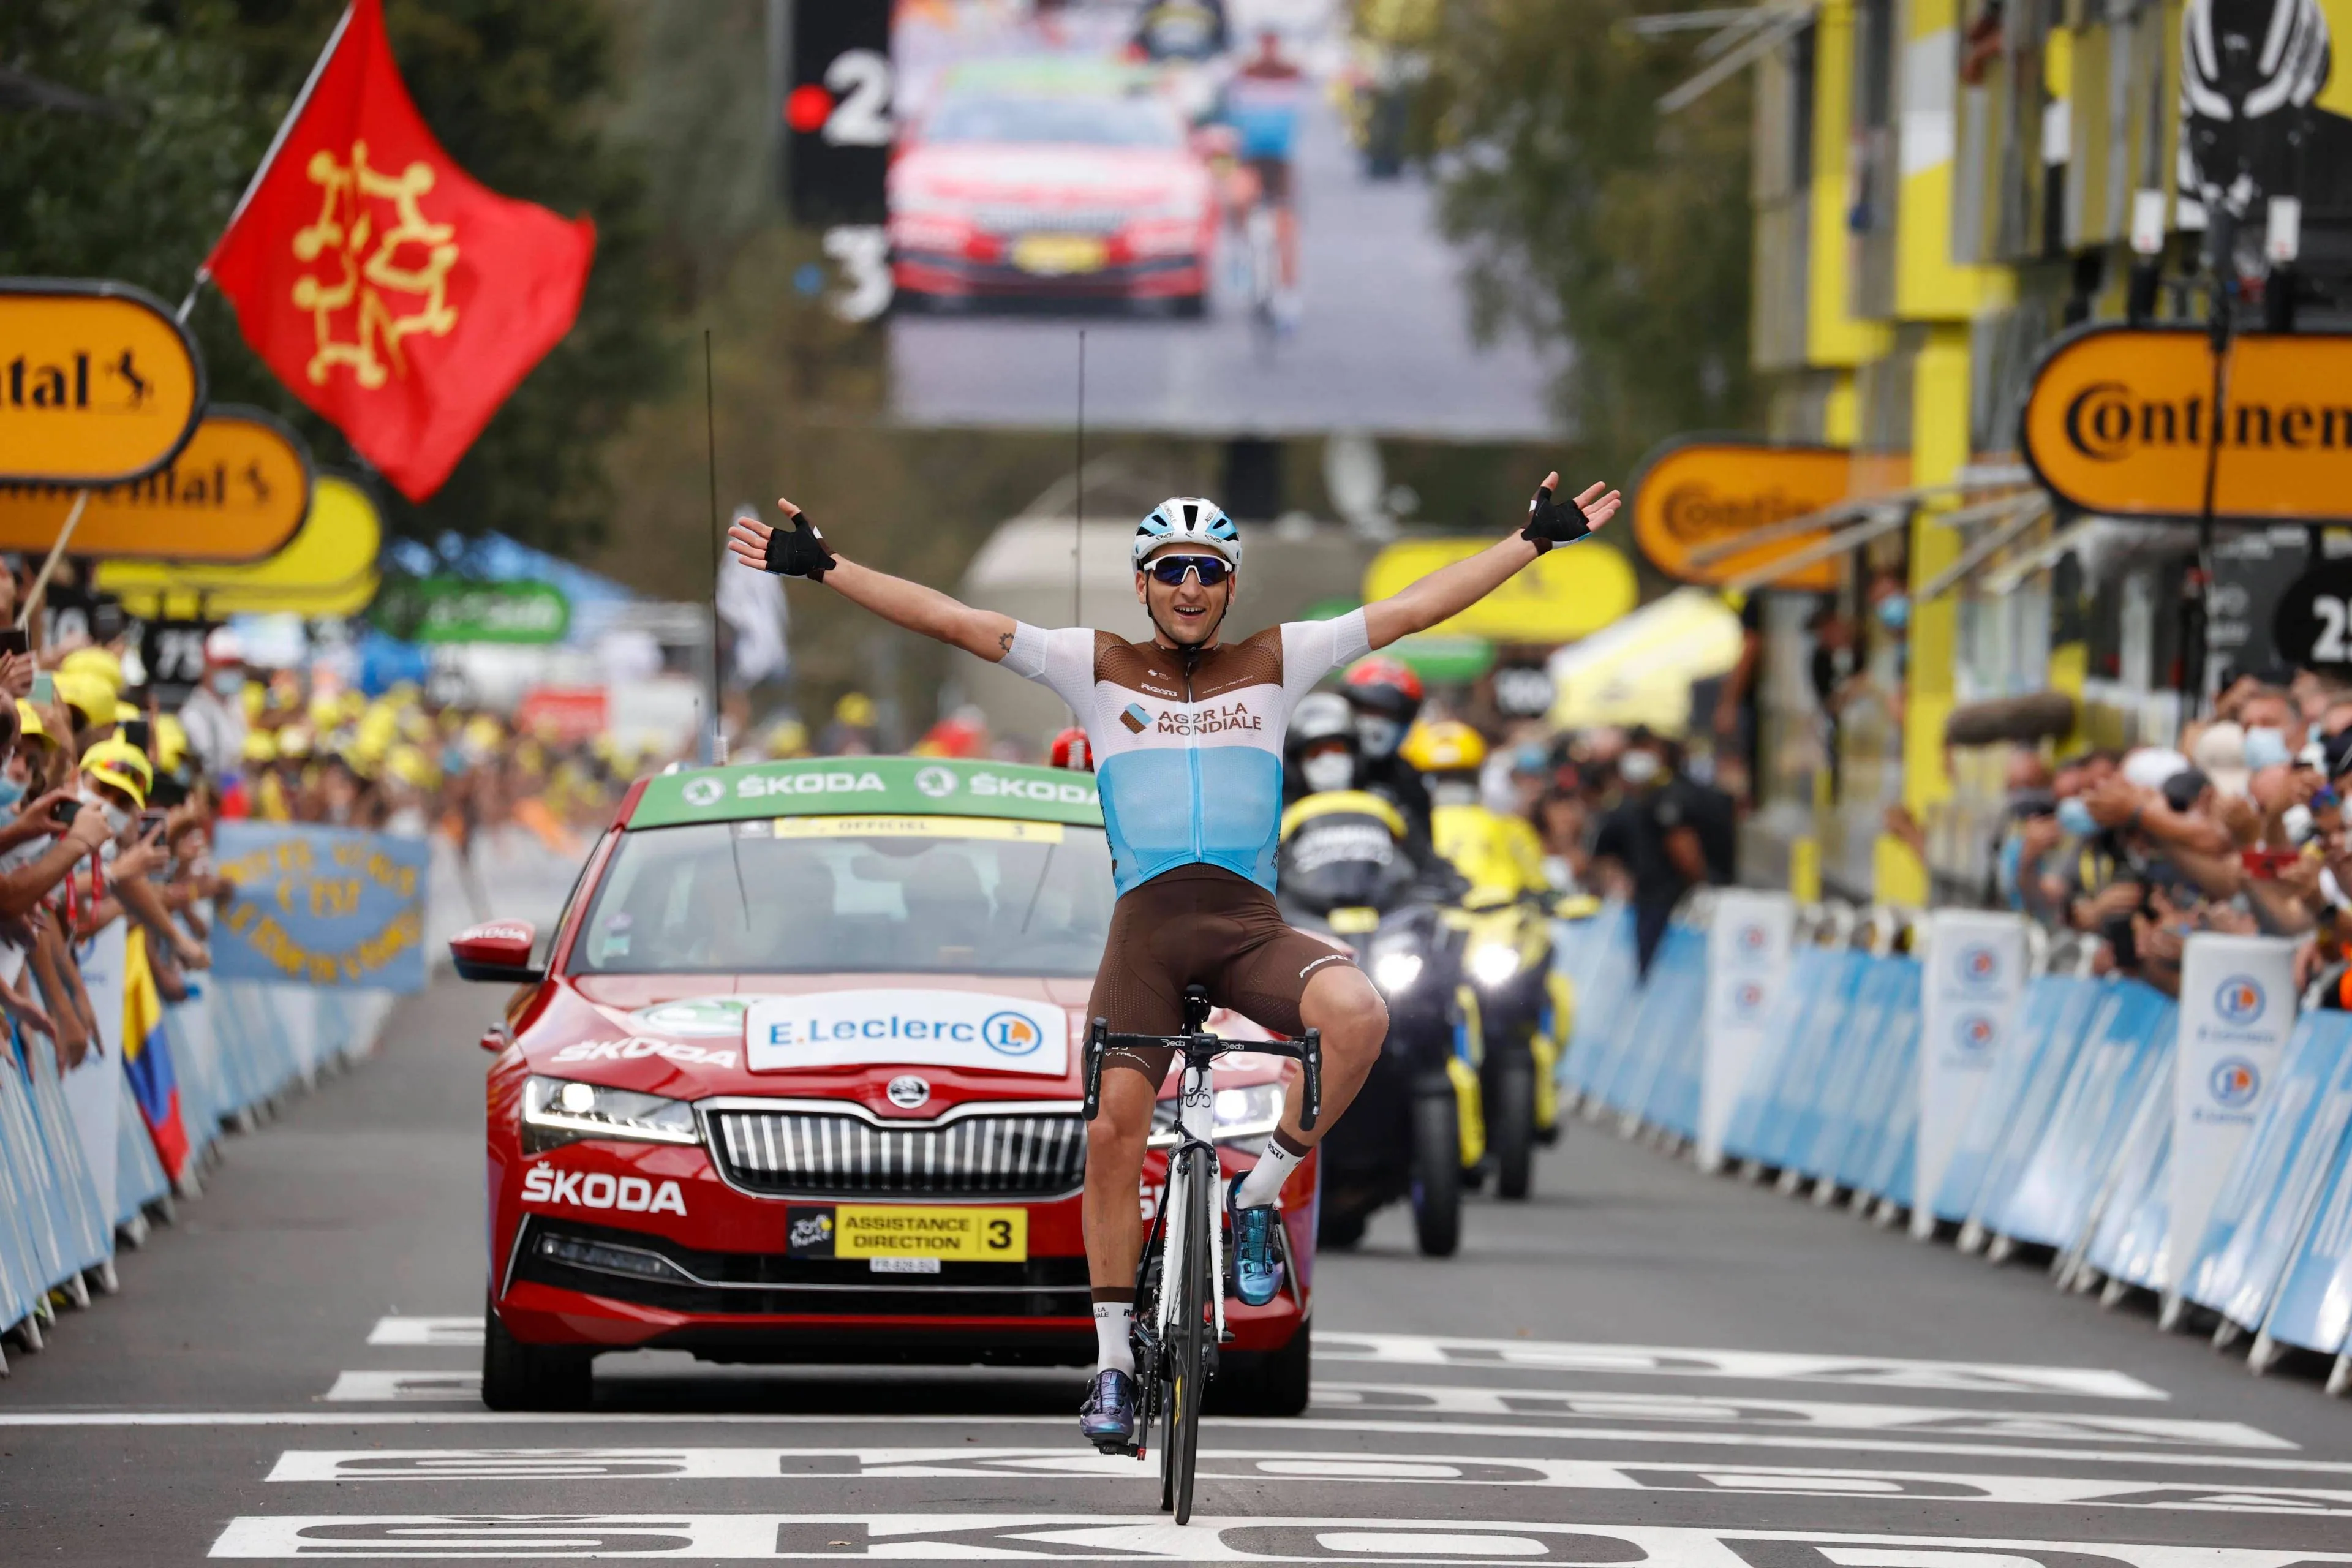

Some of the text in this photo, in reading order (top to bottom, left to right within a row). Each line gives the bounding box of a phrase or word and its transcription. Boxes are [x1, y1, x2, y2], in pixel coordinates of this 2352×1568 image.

[1159, 703, 1248, 725] AG2R LA
[1158, 715, 1261, 736] MONDIALE
[737, 773, 886, 798] ŠKODA
[839, 821, 929, 832] OFFICIEL
[769, 1015, 974, 1046] E.Leclerc
[521, 1161, 687, 1216] ŠKODA
[845, 1216, 970, 1232] ASSISTANCE
[988, 1220, 1012, 1250] 3
[853, 1235, 961, 1250] DIRECTION
